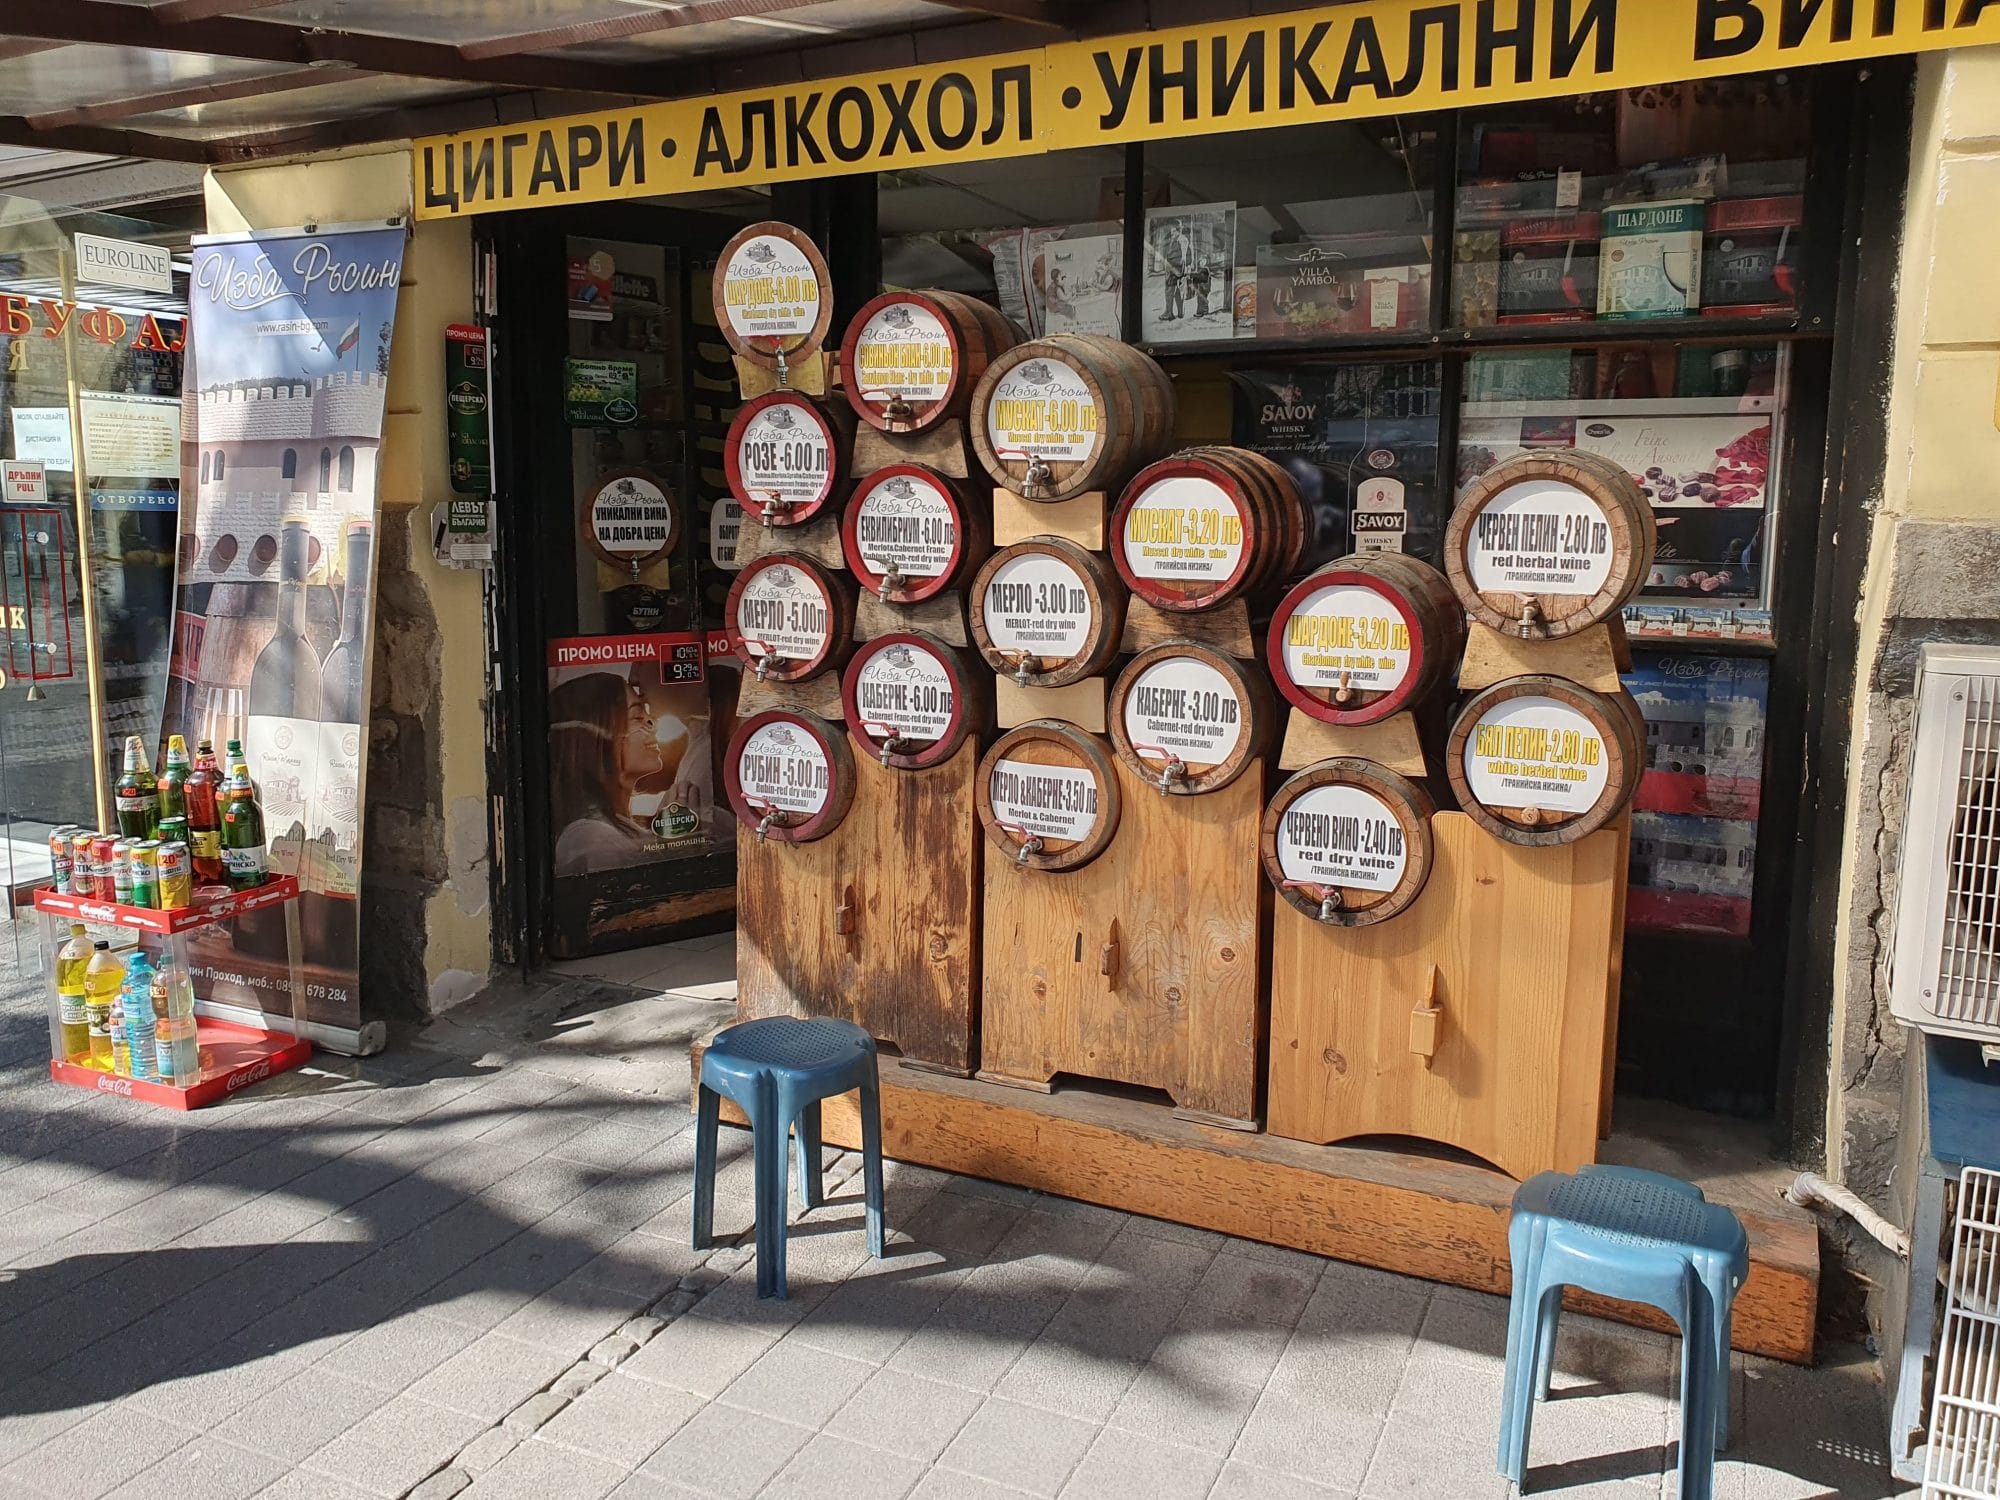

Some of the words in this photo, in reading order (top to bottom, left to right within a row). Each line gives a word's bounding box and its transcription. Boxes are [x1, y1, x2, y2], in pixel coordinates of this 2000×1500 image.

[423, 117, 646, 212] ЦИГАРИ
[693, 63, 1034, 177] АЛКОХОЛ
[1093, 0, 1614, 131] УНИКАЛНИ
[1616, 208, 1684, 228] ШАРДОНЕ
[84, 244, 167, 274] EUROLINE
[197, 251, 284, 307] Изба
[293, 242, 399, 295] Ръсин
[1290, 275, 1339, 287] YAMBOL
[1299, 266, 1330, 278] VILLA
[447, 329, 467, 340] ПРОМО
[468, 331, 485, 341] ЦЕНА
[451, 394, 484, 404] ПЕЩЕРСКА
[995, 399, 1079, 432] МУСКАТ-6.00
[1260, 404, 1317, 425] SAVOY
[1271, 425, 1307, 433] WHISKY
[744, 442, 777, 471] РОЗЕ
[780, 442, 813, 472] -6.00
[8, 471, 42, 481] ДРЪПНИ
[16, 483, 35, 492] PULL
[97, 495, 176, 505] ОТВОРЕНО
[451, 501, 484, 514] ЛЕВЪТ
[451, 517, 487, 527] БЪЛГАРИЯ
[595, 507, 643, 521] УНИКАЛНИ
[644, 506, 667, 521] ВИНА
[1356, 514, 1403, 531] SAVOY
[598, 527, 612, 541] НА
[612, 526, 643, 543] ДОБРА
[644, 526, 667, 542] ЦЕНА
[861, 515, 920, 545] ЕКВИЛИБРИУМ
[921, 517, 943, 545] -6.00
[1129, 507, 1220, 545] МУСКАТ-3.20
[1478, 512, 1521, 552] ЧЕРВЕН
[1521, 513, 1560, 554] ПЕЛИН
[1560, 514, 1590, 554] -2.80
[1363, 537, 1394, 545] WHISKY
[1492, 555, 1513, 568] red
[1515, 555, 1558, 570] herbal
[1559, 557, 1592, 571] wine
[991, 583, 1032, 614] МЕРЛО
[1035, 583, 1067, 614] -3.00
[743, 599, 785, 631] МЕРЛО
[1288, 614, 1389, 653] ШАРДОНЕ-3.20
[558, 645, 613, 663] ПРОМО
[617, 643, 656, 660] ЦЕНА
[862, 682, 908, 711] КАБЕРНЕ
[909, 685, 938, 713] -6.00
[1136, 686, 1187, 720] КАБЕРНЕ
[1188, 690, 1219, 723] -3.00
[1147, 718, 1193, 735] Cabernet-red
[1193, 723, 1206, 738] dry
[1206, 724, 1225, 738] wine
[1476, 723, 1504, 758] БЯЛ
[1504, 725, 1580, 765] ПЕЛИН-2.80
[743, 753, 781, 784] РУБИН
[783, 758, 813, 788] -5.00
[1487, 760, 1519, 776] white
[1519, 762, 1558, 780] herbal
[1558, 765, 1588, 782] wine
[993, 770, 1019, 805] МЕРЛО
[654, 814, 696, 829] ПЕЩЕРСКА
[1008, 807, 1032, 820] Merlot
[1039, 812, 1076, 826] Cabernet
[1286, 810, 1330, 850] ЧЕРВЕНО
[1331, 815, 1360, 853] ВИНО
[1360, 817, 1387, 857] -2.40
[1298, 849, 1324, 863] red
[1328, 851, 1354, 867] dry
[1358, 856, 1397, 871] wine
[206, 966, 246, 986] Проход,
[247, 976, 274, 991] моб.:
[306, 984, 325, 999] 678
[328, 987, 348, 1002] 284
